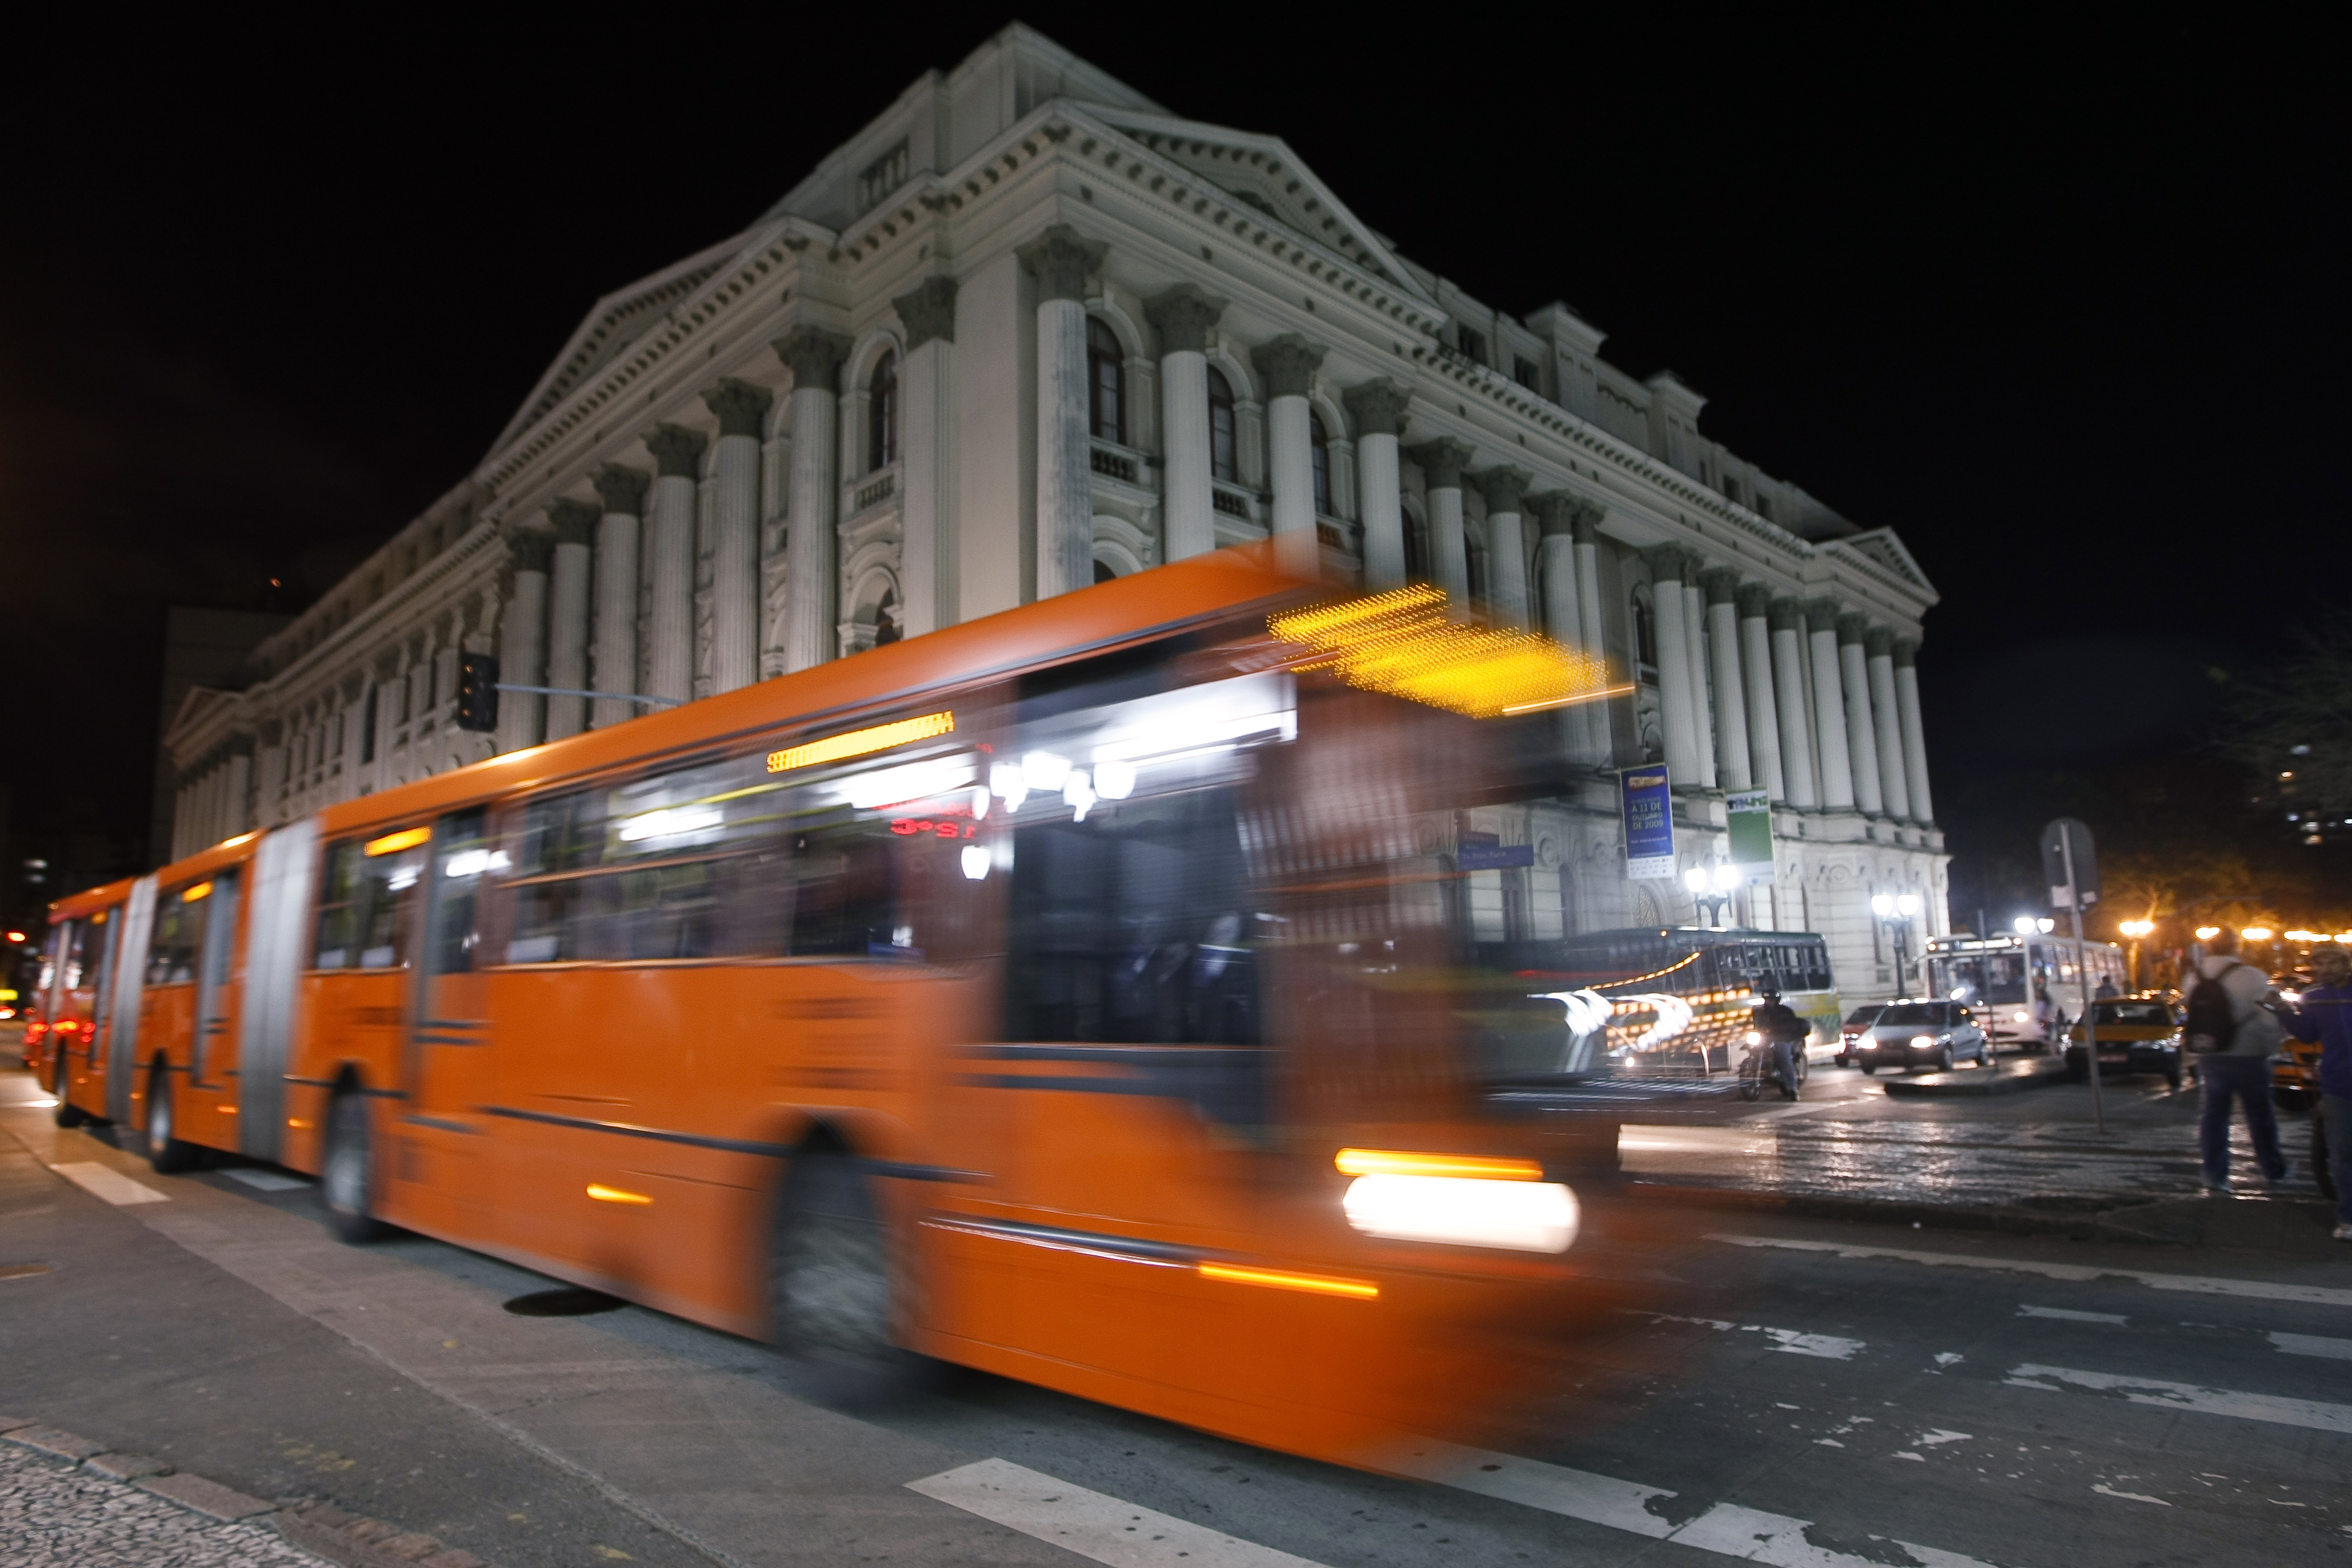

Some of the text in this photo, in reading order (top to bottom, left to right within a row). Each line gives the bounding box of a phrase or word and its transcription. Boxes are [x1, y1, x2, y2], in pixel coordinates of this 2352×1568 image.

[1640, 803, 1647, 812] 11
[1651, 802, 1662, 811] DE
[1632, 812, 1663, 821] OUTUBRO
[1645, 819, 1664, 829] 2009
